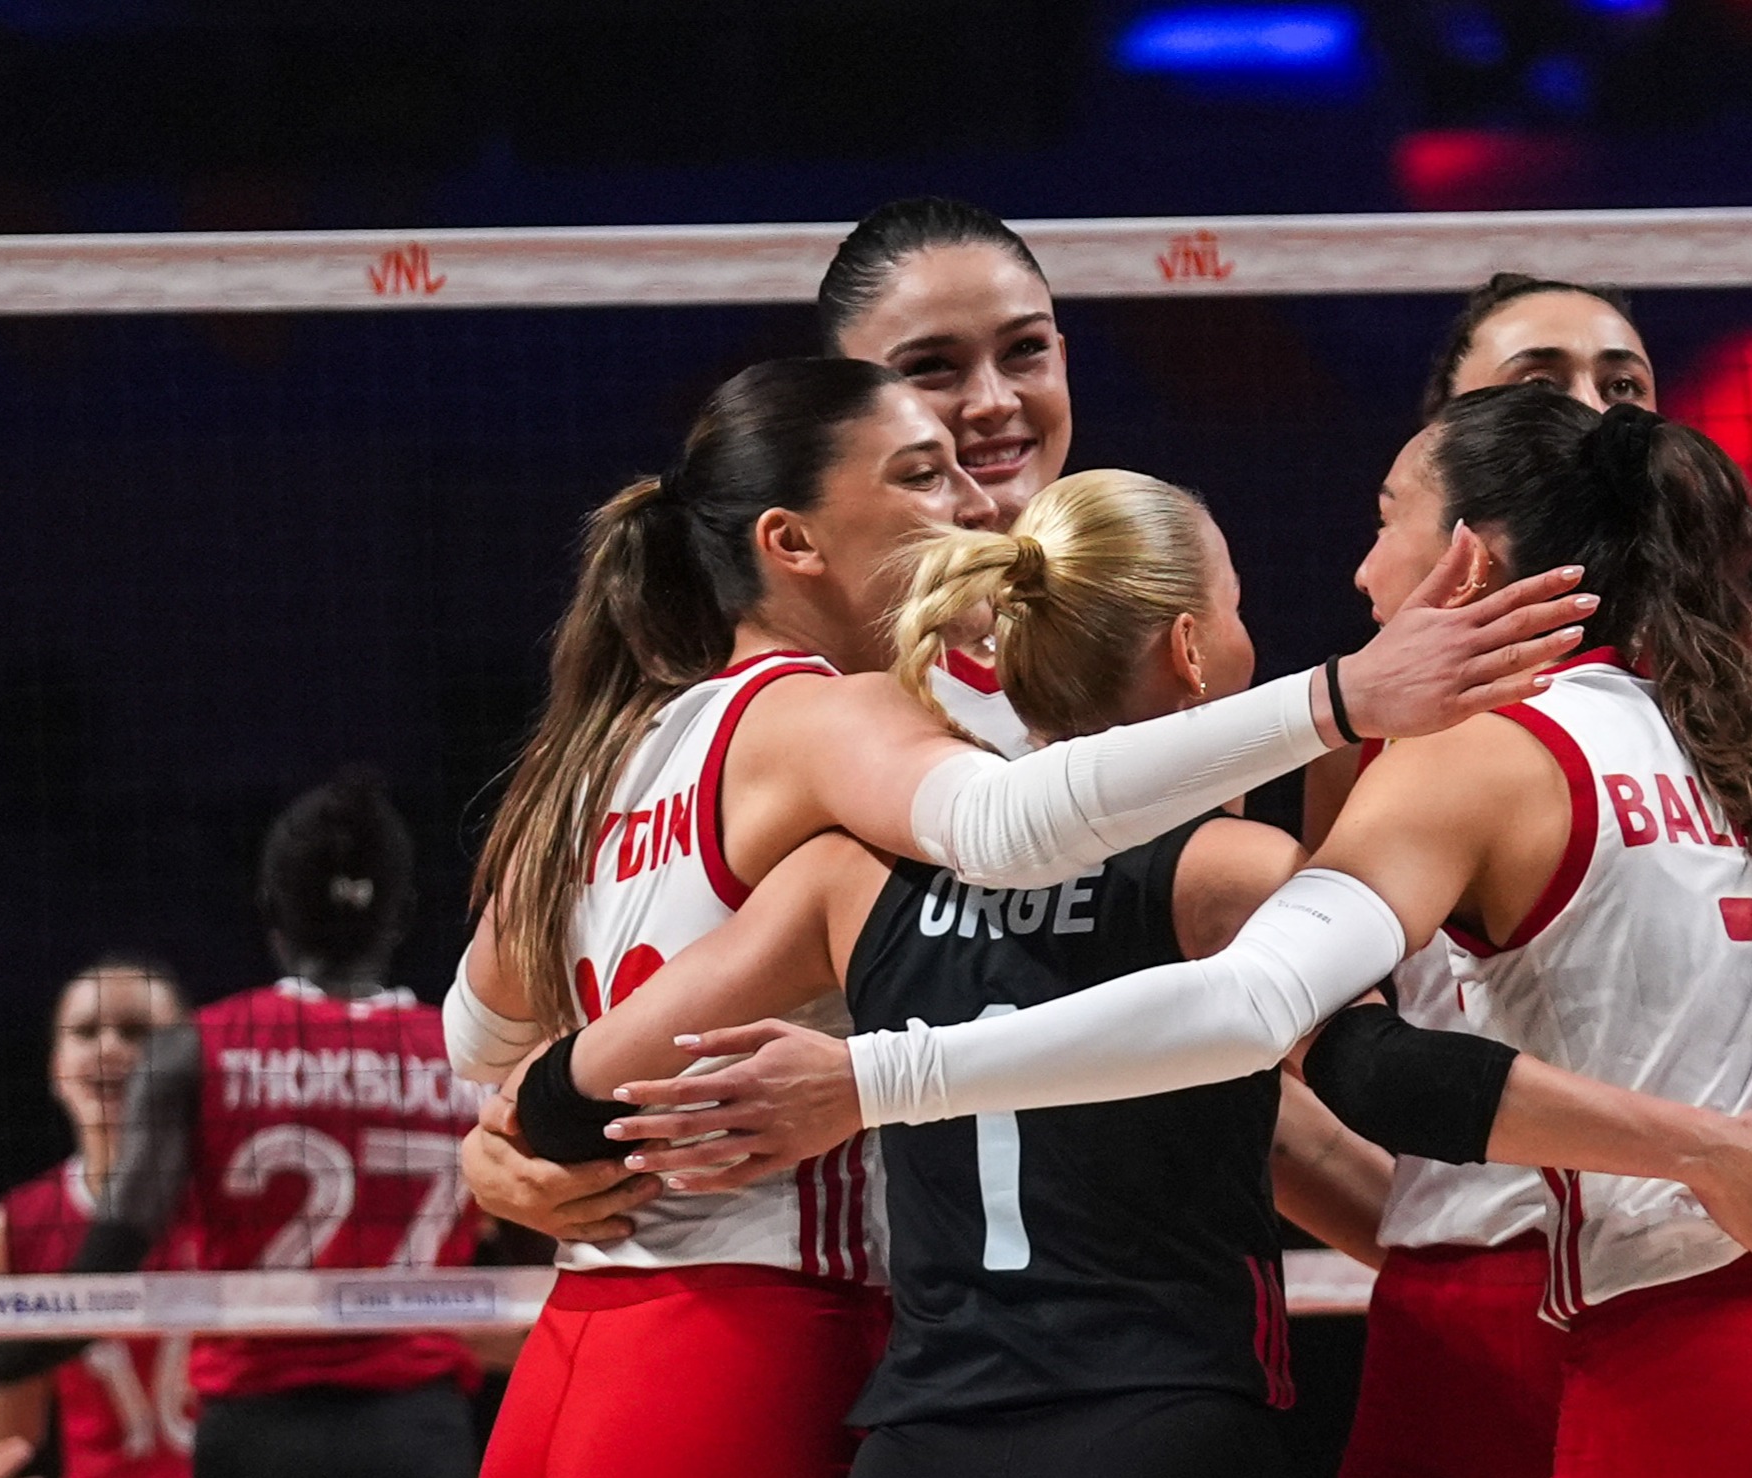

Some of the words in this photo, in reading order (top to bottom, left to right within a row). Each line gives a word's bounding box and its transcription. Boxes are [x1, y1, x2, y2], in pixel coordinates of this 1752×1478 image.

[368, 242, 446, 291] VNL
[1157, 230, 1234, 283] VNL
[579, 784, 695, 886] YDIN
[974, 1004, 1031, 1270] 1
[223, 1124, 466, 1274] 27
